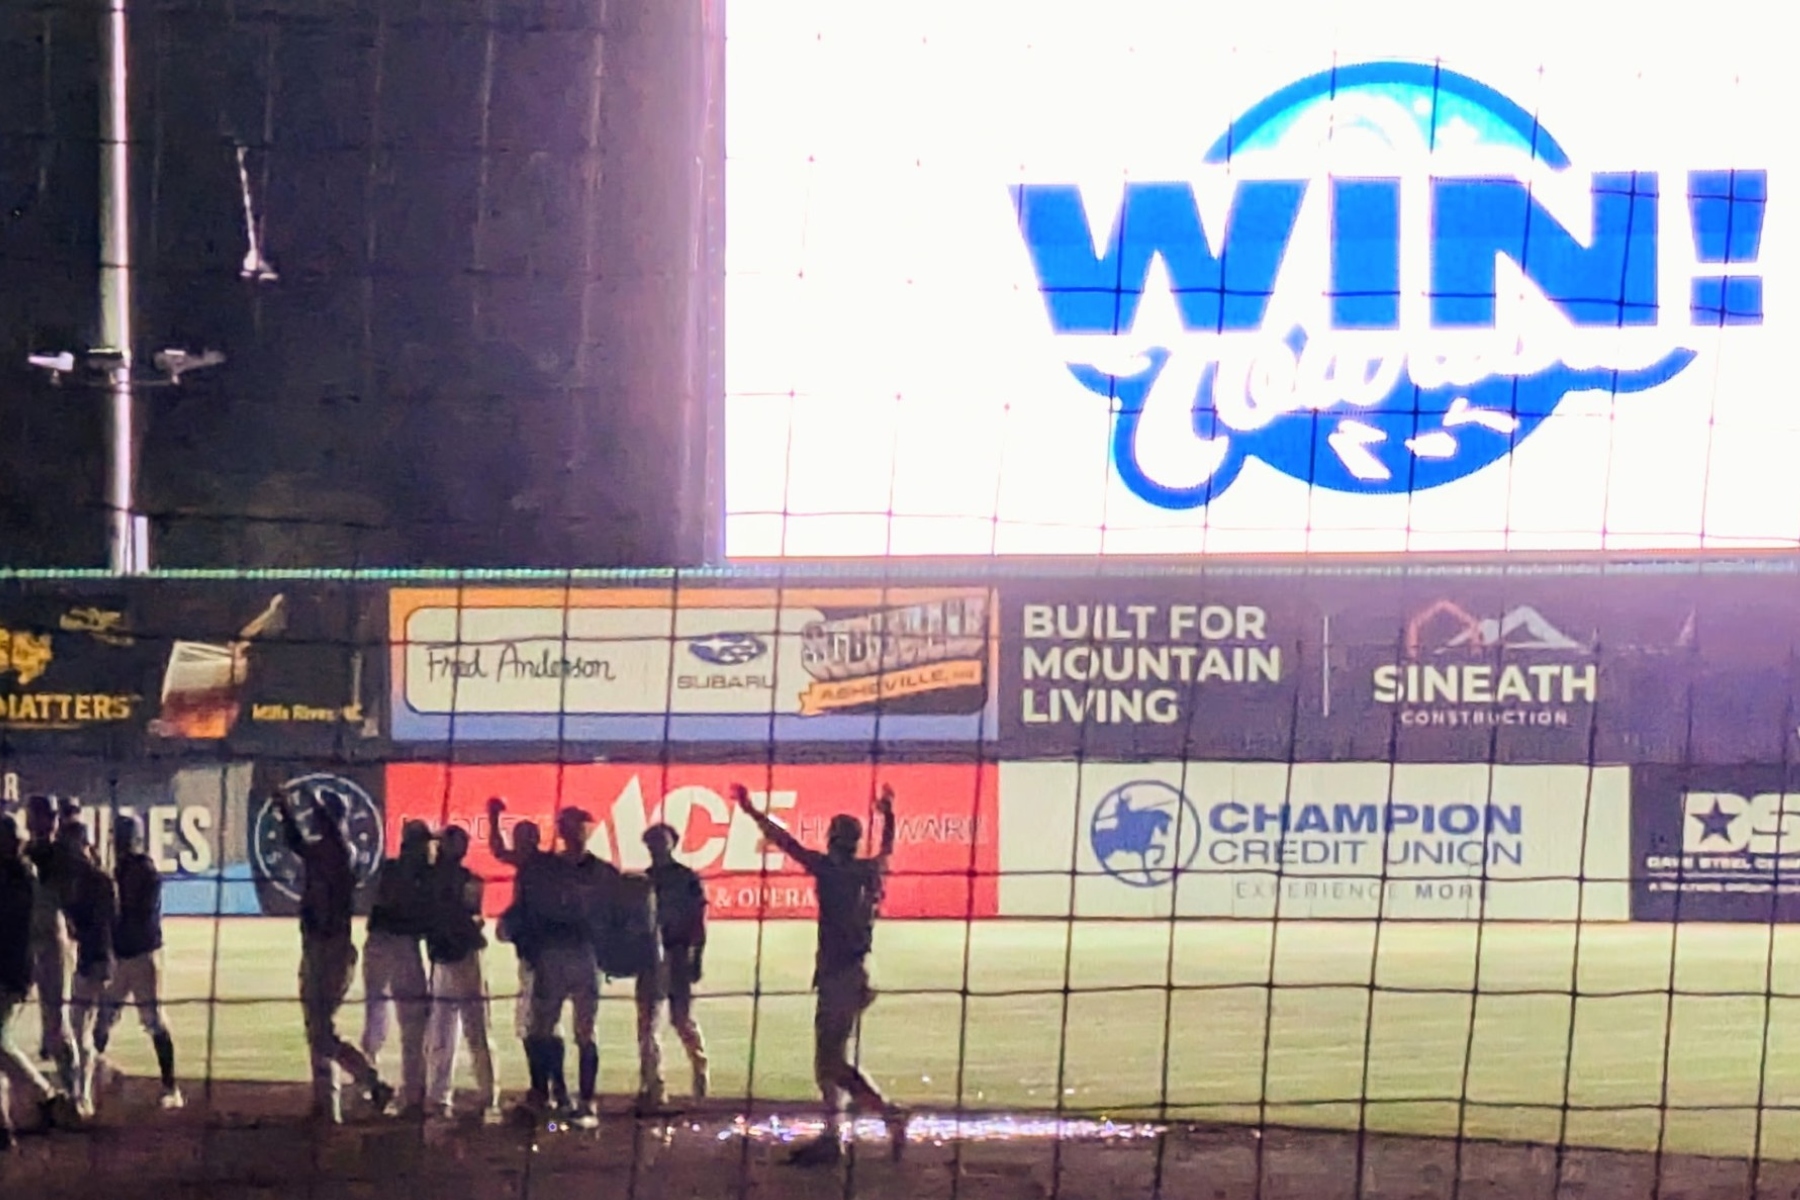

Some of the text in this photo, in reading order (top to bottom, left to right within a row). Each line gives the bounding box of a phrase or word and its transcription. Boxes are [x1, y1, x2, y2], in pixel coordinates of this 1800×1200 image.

[1007, 168, 1768, 336] WIN!
[1023, 604, 1156, 640] BUILT
[1169, 604, 1266, 640] FOR
[426, 640, 616, 683] Fred Anderson
[1022, 645, 1280, 682] MOUNTAIN
[1372, 664, 1597, 703] SINEATH
[1022, 688, 1179, 723] LIVING
[1400, 710, 1569, 726] CONSTRUCTION
[1209, 803, 1522, 835] CHAMPION
[1208, 839, 1523, 867] CREDIT UNION
[715, 887, 733, 909] &
